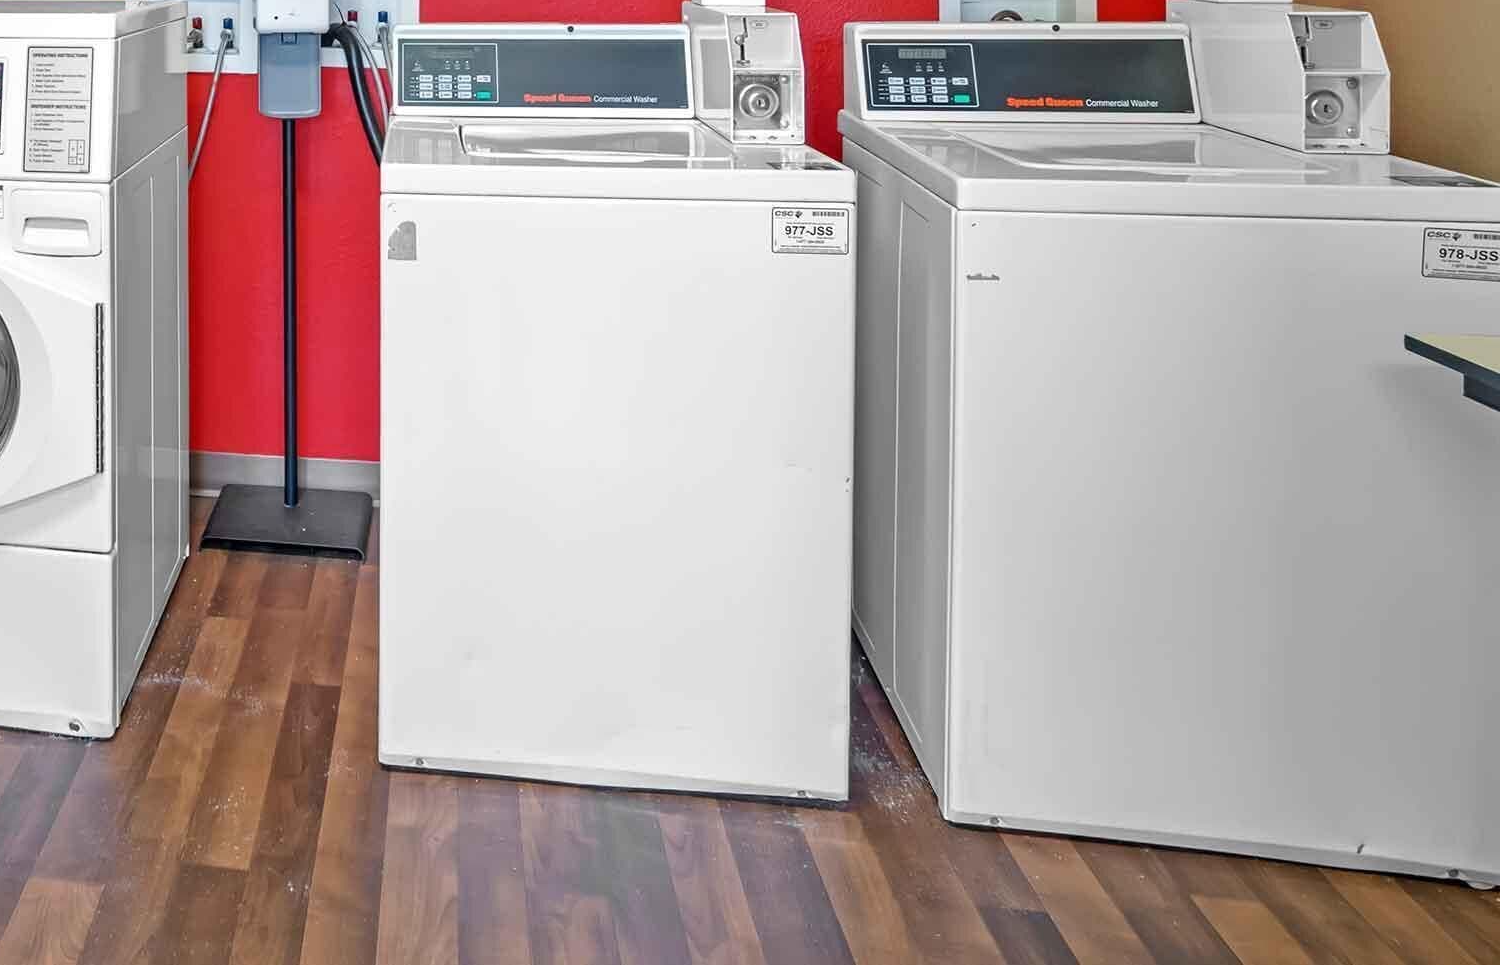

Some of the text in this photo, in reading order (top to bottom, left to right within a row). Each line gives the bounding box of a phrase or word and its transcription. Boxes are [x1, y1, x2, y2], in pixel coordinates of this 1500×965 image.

[523, 93, 658, 104] Speed Queen Commercial Washer
[1006, 97, 1159, 108] Speed Queen Commercial Washer
[784, 225, 834, 236] 977-JSS
[1427, 231, 1451, 239] CSC
[1439, 247, 1499, 262] 978-JSS
